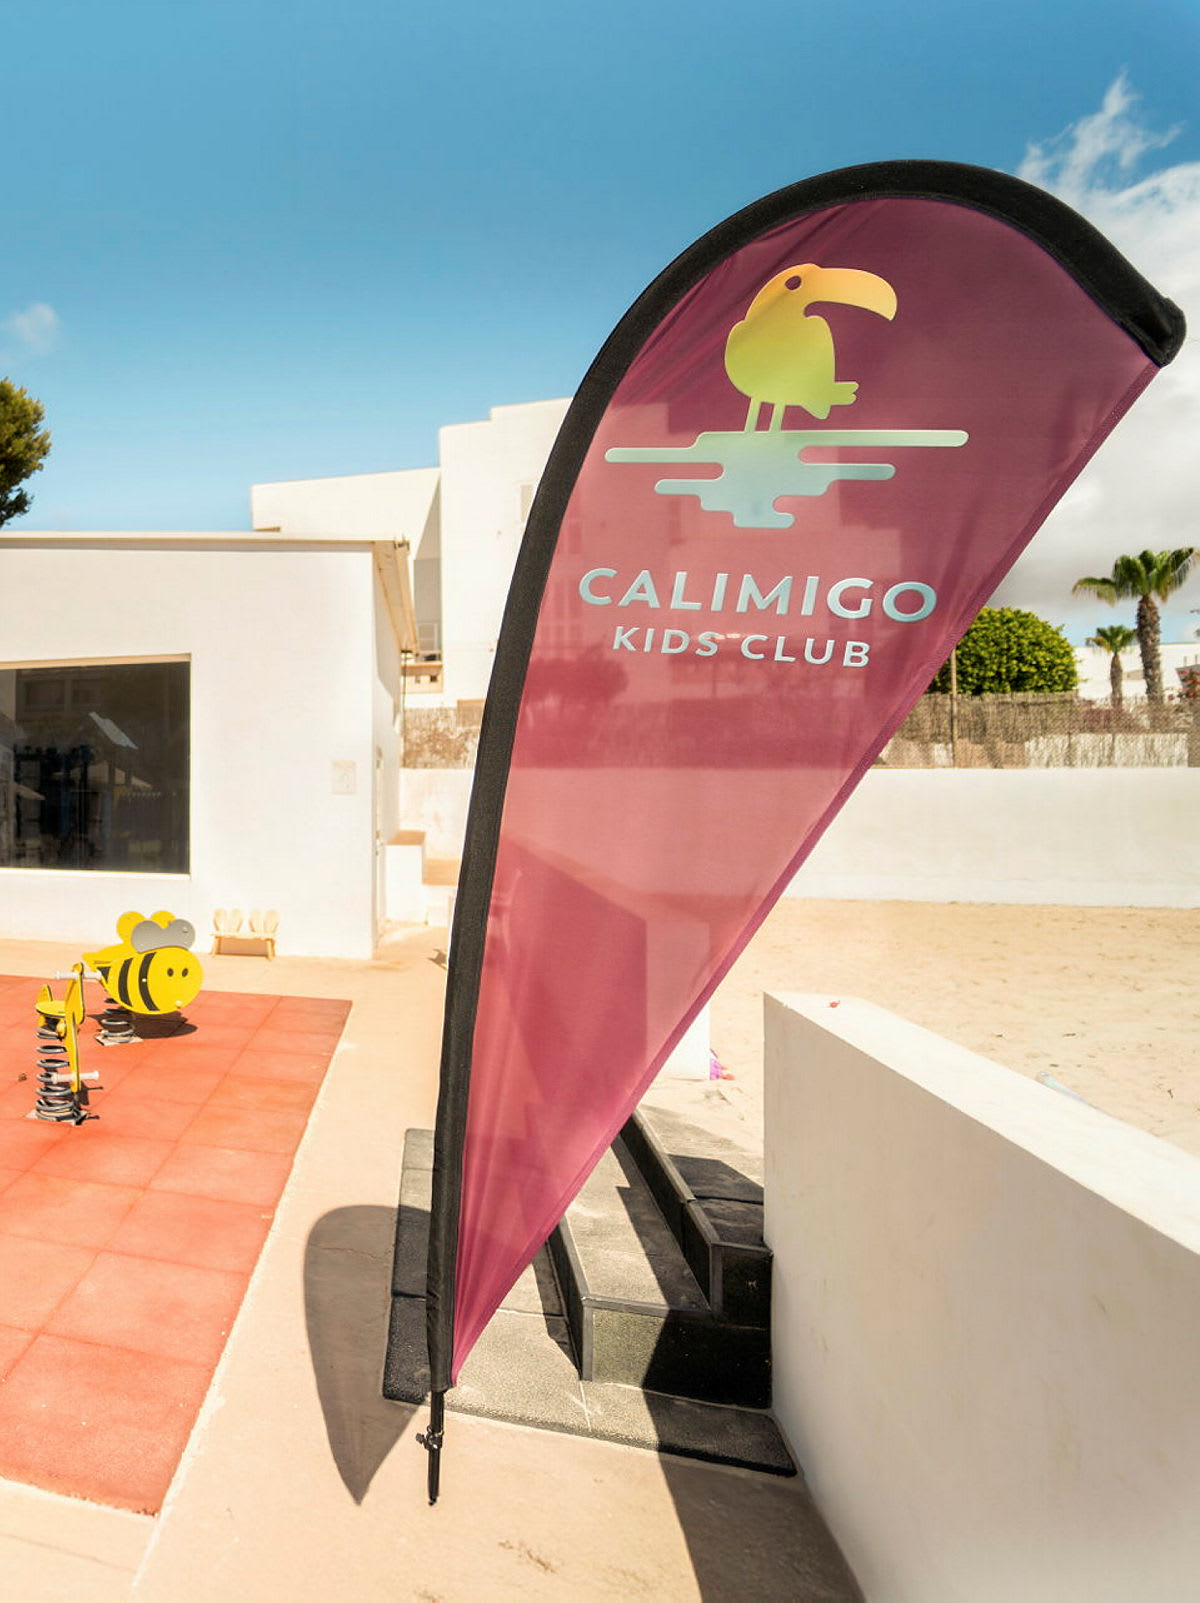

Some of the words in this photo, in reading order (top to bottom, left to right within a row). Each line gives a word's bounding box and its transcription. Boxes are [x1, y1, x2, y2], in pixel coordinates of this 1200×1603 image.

[578, 568, 937, 622] CALIMIGO
[612, 626, 719, 656] KIDS
[740, 634, 871, 668] CLUB
